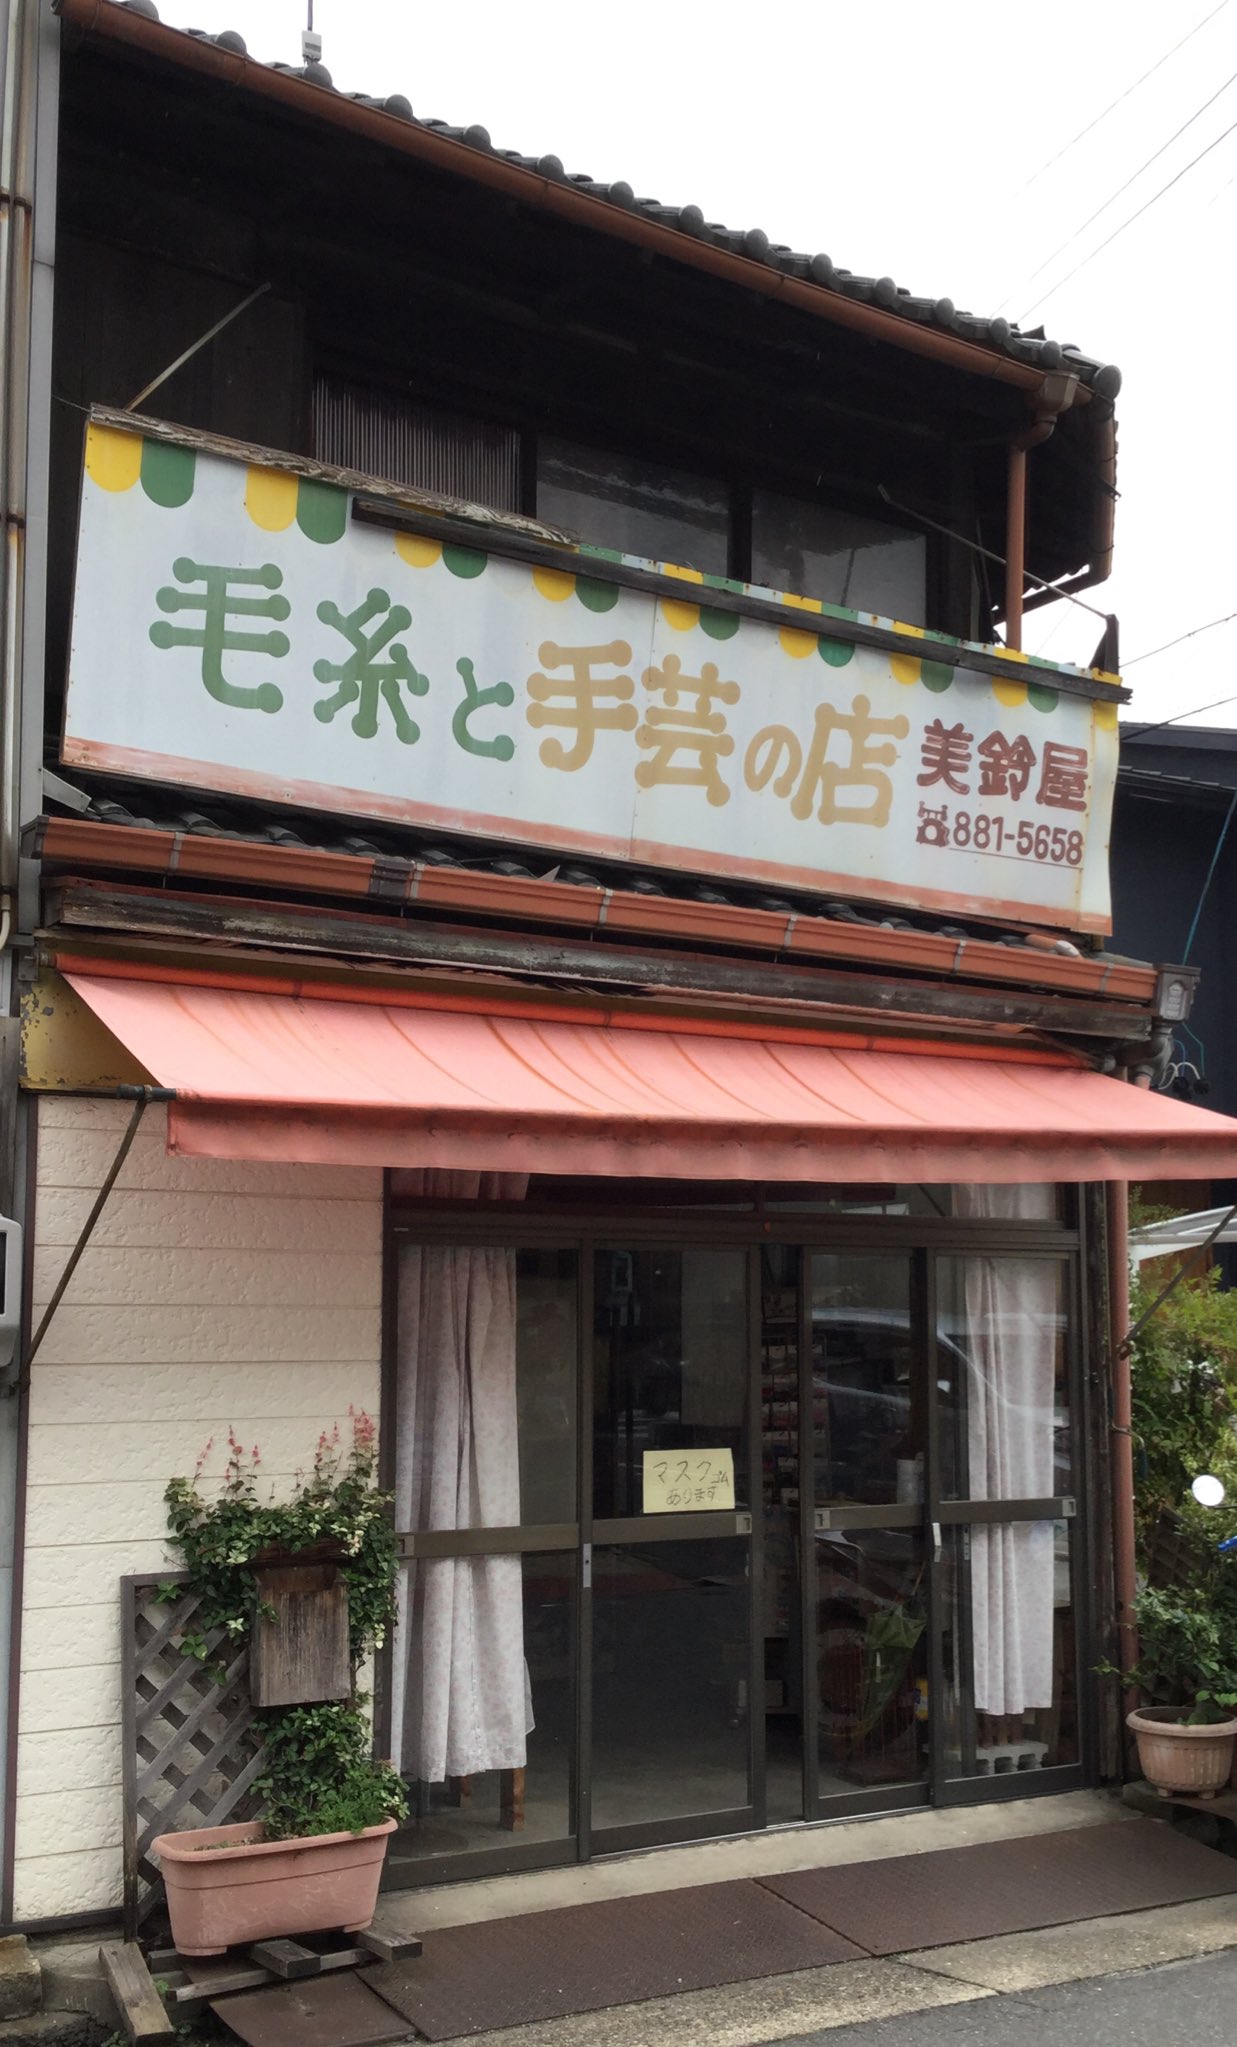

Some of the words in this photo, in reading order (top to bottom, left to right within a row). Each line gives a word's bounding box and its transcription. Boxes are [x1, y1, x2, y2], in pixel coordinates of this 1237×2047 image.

[148, 556, 910, 829] 毛糸と手芸の店
[916, 718, 1088, 812] 美鈴屋
[952, 811, 1084, 866] 881-5658
[665, 1485, 718, 1506] あります
